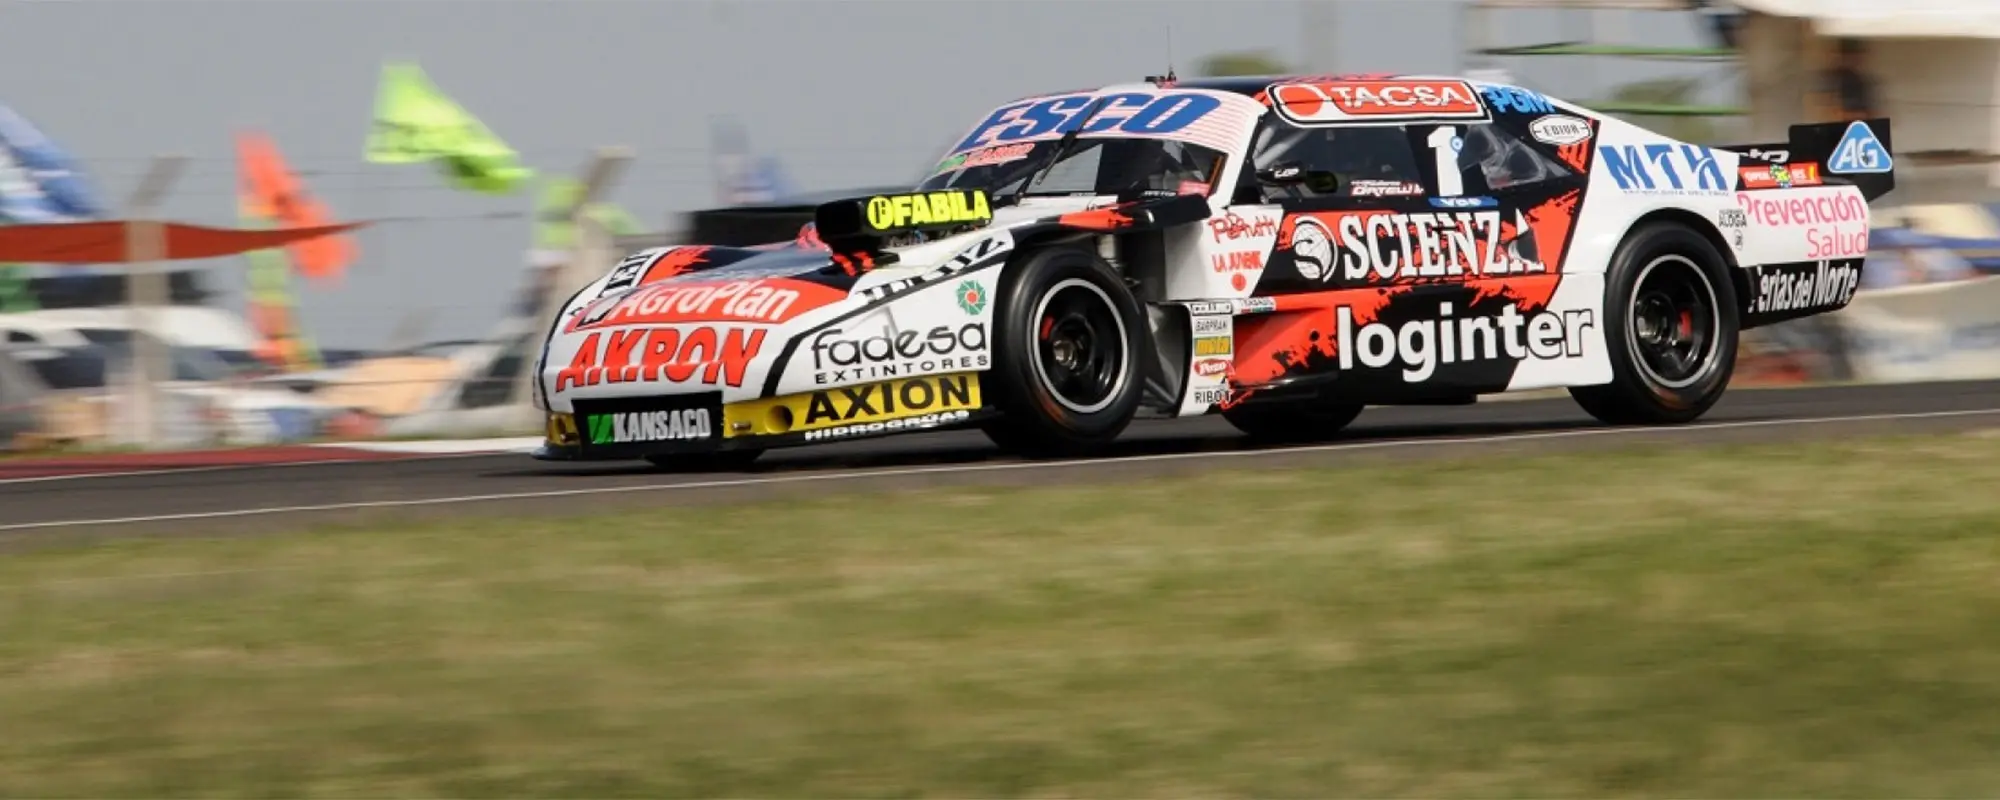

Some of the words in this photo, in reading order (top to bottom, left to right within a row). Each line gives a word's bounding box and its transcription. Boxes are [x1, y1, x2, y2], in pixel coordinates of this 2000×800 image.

[1331, 86, 1472, 108] TACSA
[952, 92, 1222, 155] ESCO
[1427, 126, 1464, 196] 1
[1600, 144, 1729, 190] MTH
[1836, 137, 1878, 168] AG
[892, 190, 992, 226] FABILA
[1737, 188, 1865, 227] Prevención
[1343, 208, 1546, 281] SCIENZA
[1807, 224, 1867, 258] Salud
[1812, 260, 1858, 306] Norte
[555, 327, 768, 393] AKRON
[812, 322, 989, 368] fadesa
[1335, 303, 1594, 383] loginter
[815, 355, 988, 384] EXTINTORES
[805, 376, 971, 424] AXION
[614, 408, 711, 442] KANSACO
